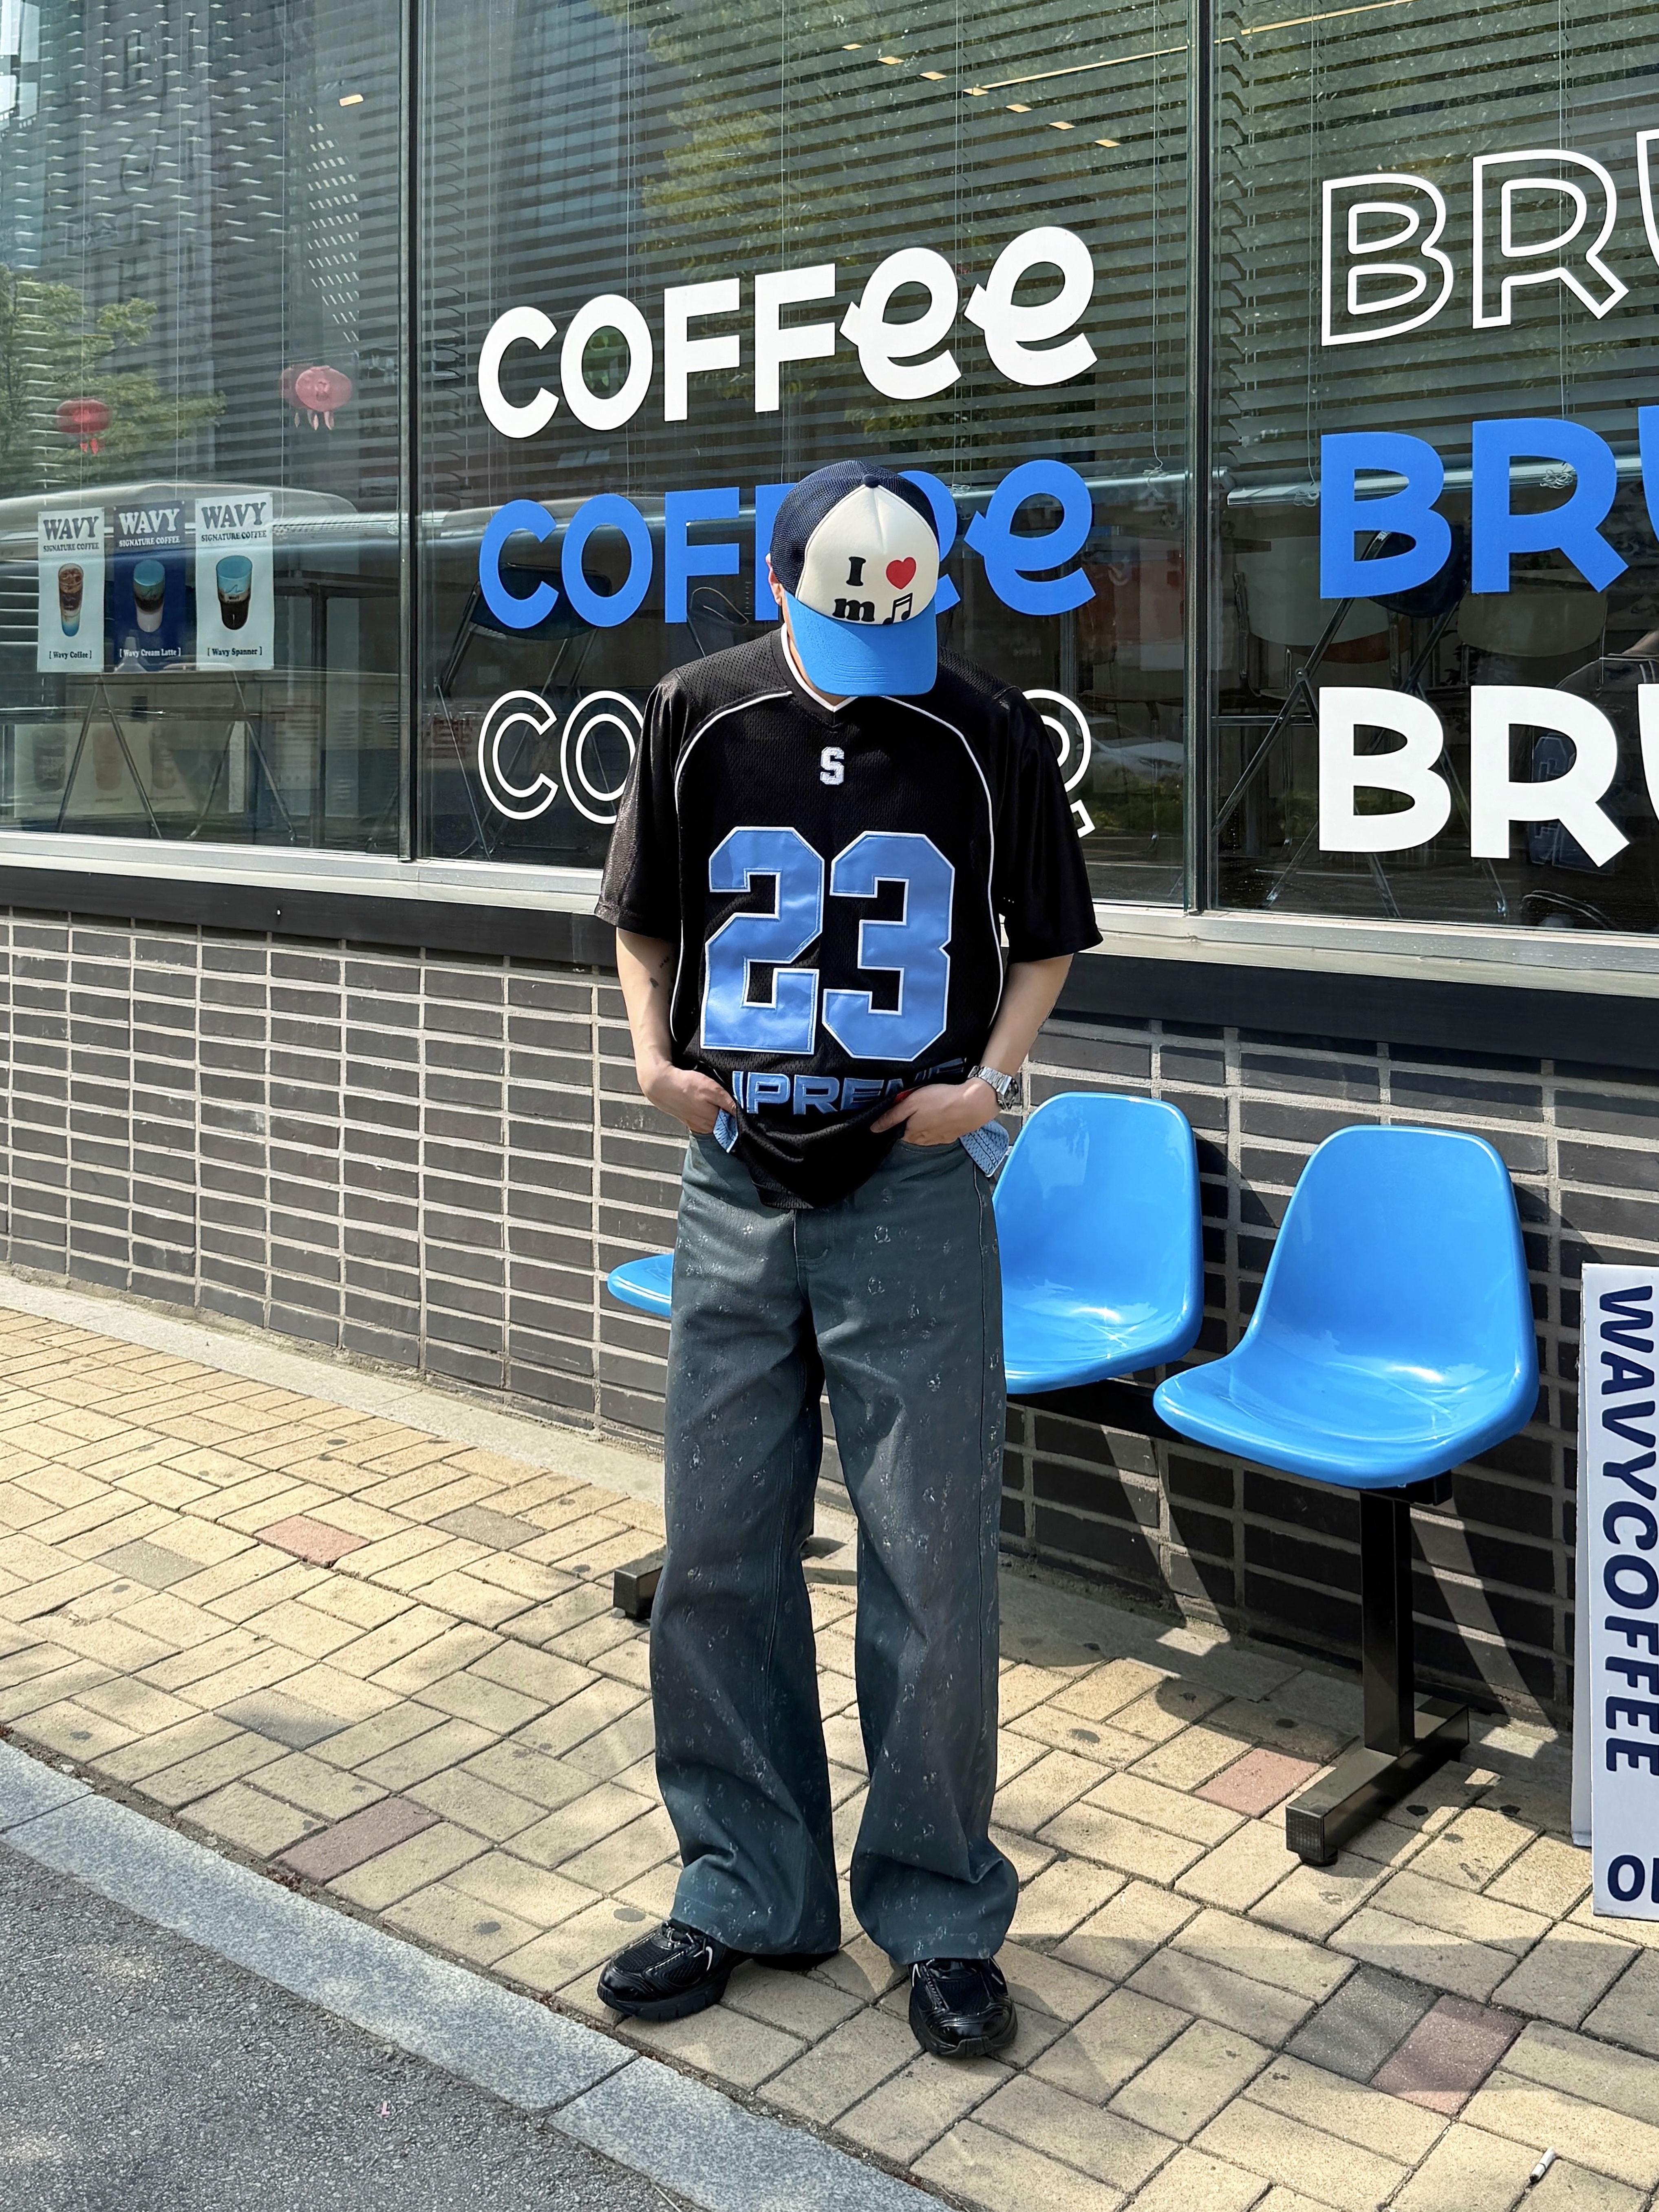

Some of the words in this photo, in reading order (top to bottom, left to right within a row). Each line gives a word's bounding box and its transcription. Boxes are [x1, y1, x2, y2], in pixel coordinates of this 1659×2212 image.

[1321, 128, 1659, 346] BR
[201, 502, 267, 529] WAVY
[1319, 406, 1659, 598] BR
[43, 516, 99, 540] WAVY
[119, 508, 180, 535] WAVY
[43, 543, 76, 552] SIGNATURE
[119, 538, 155, 547] SIGNATURE
[156, 536, 181, 544] COFFEE
[201, 532, 240, 542] SIGNATURE
[241, 530, 267, 539] COFFEE
[479, 460, 1094, 629] COFe
[846, 556, 866, 586] I
[832, 598, 875, 622] m
[53, 651, 68, 660] Wavy
[124, 649, 139, 658] Wavy
[212, 648, 230, 657] Wavy
[232, 648, 258, 656] Spanner
[820, 746, 844, 785] S
[1319, 684, 1659, 867] BR
[700, 826, 955, 1061] 23
[1607, 1854, 1659, 1904] O
